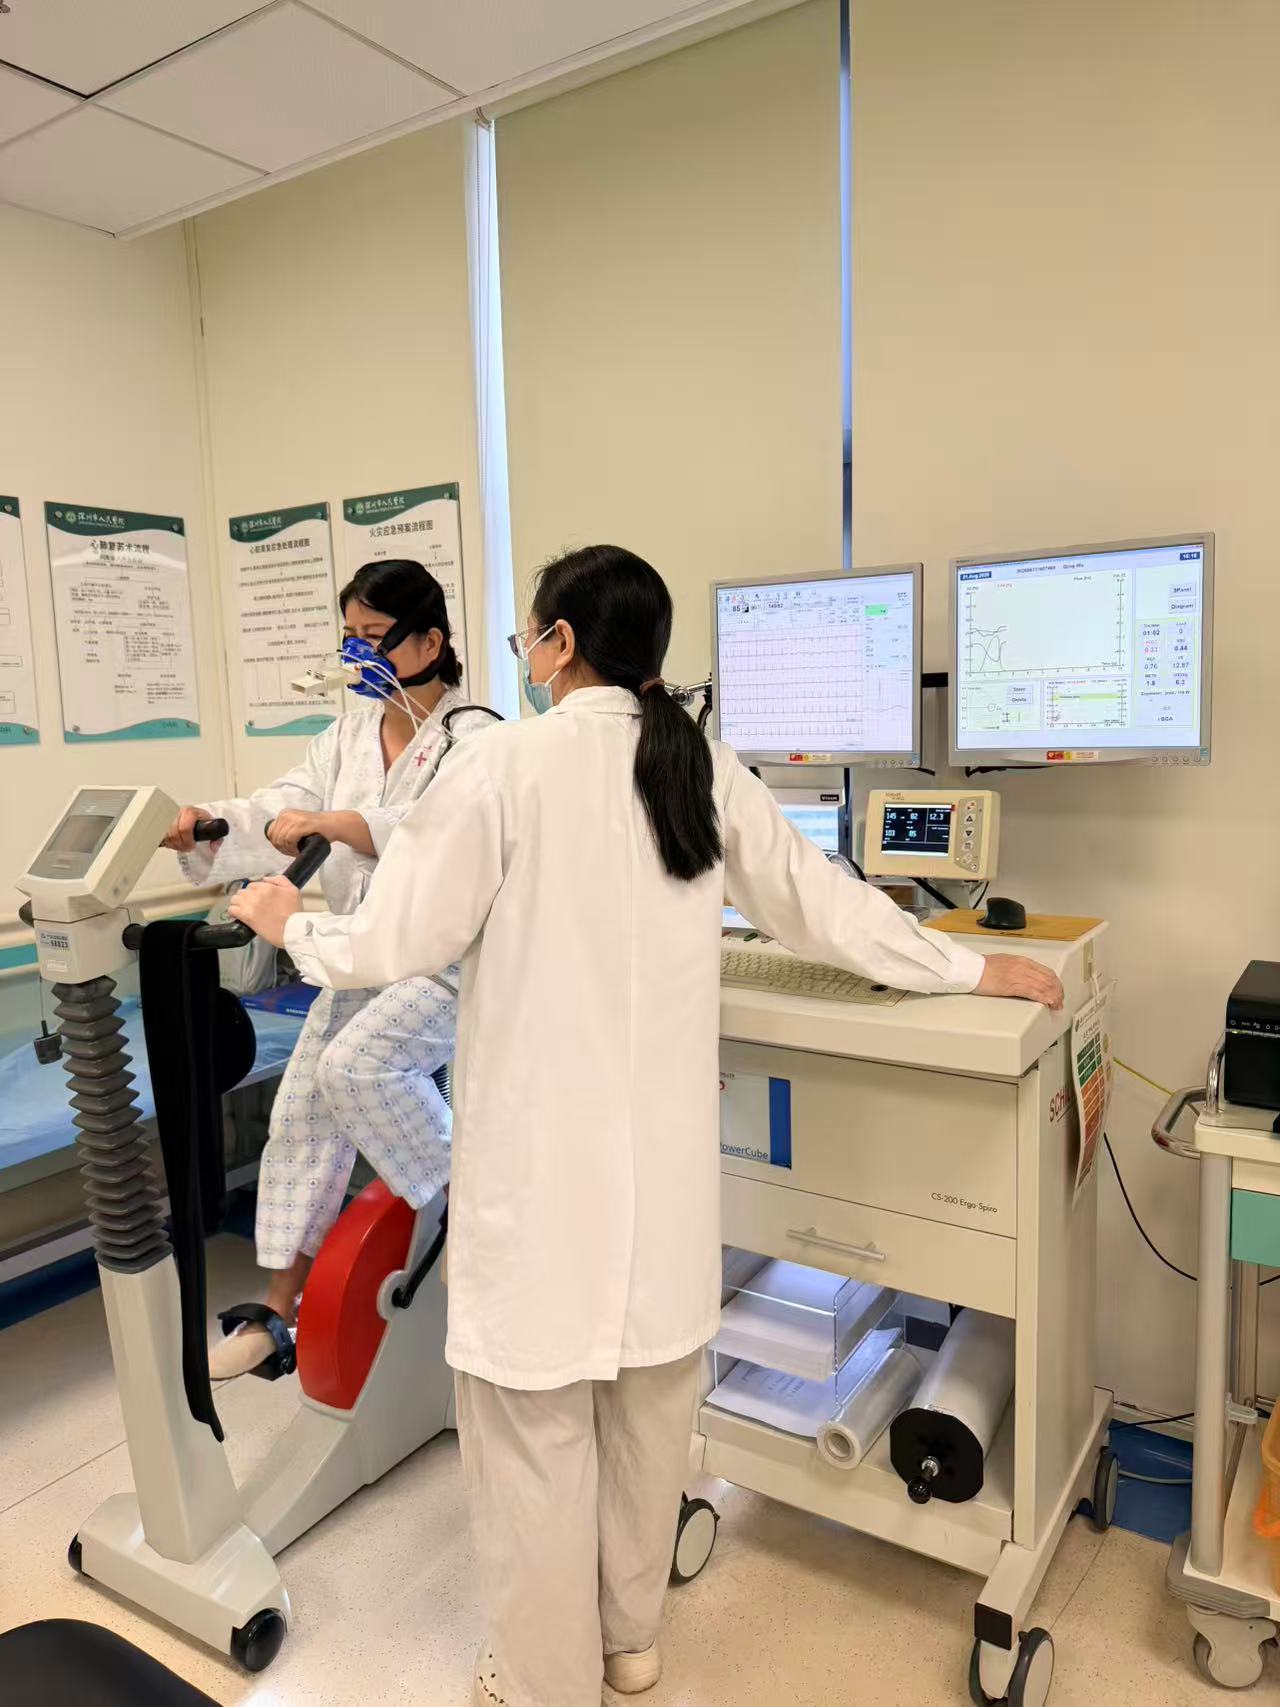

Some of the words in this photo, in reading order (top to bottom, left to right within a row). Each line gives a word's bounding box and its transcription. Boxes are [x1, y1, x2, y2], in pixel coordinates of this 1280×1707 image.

[370, 520, 433, 537] 火灾应急预案流程图
[719, 1141, 769, 1160] owerCube
[931, 1192, 958, 1205] CS-200
